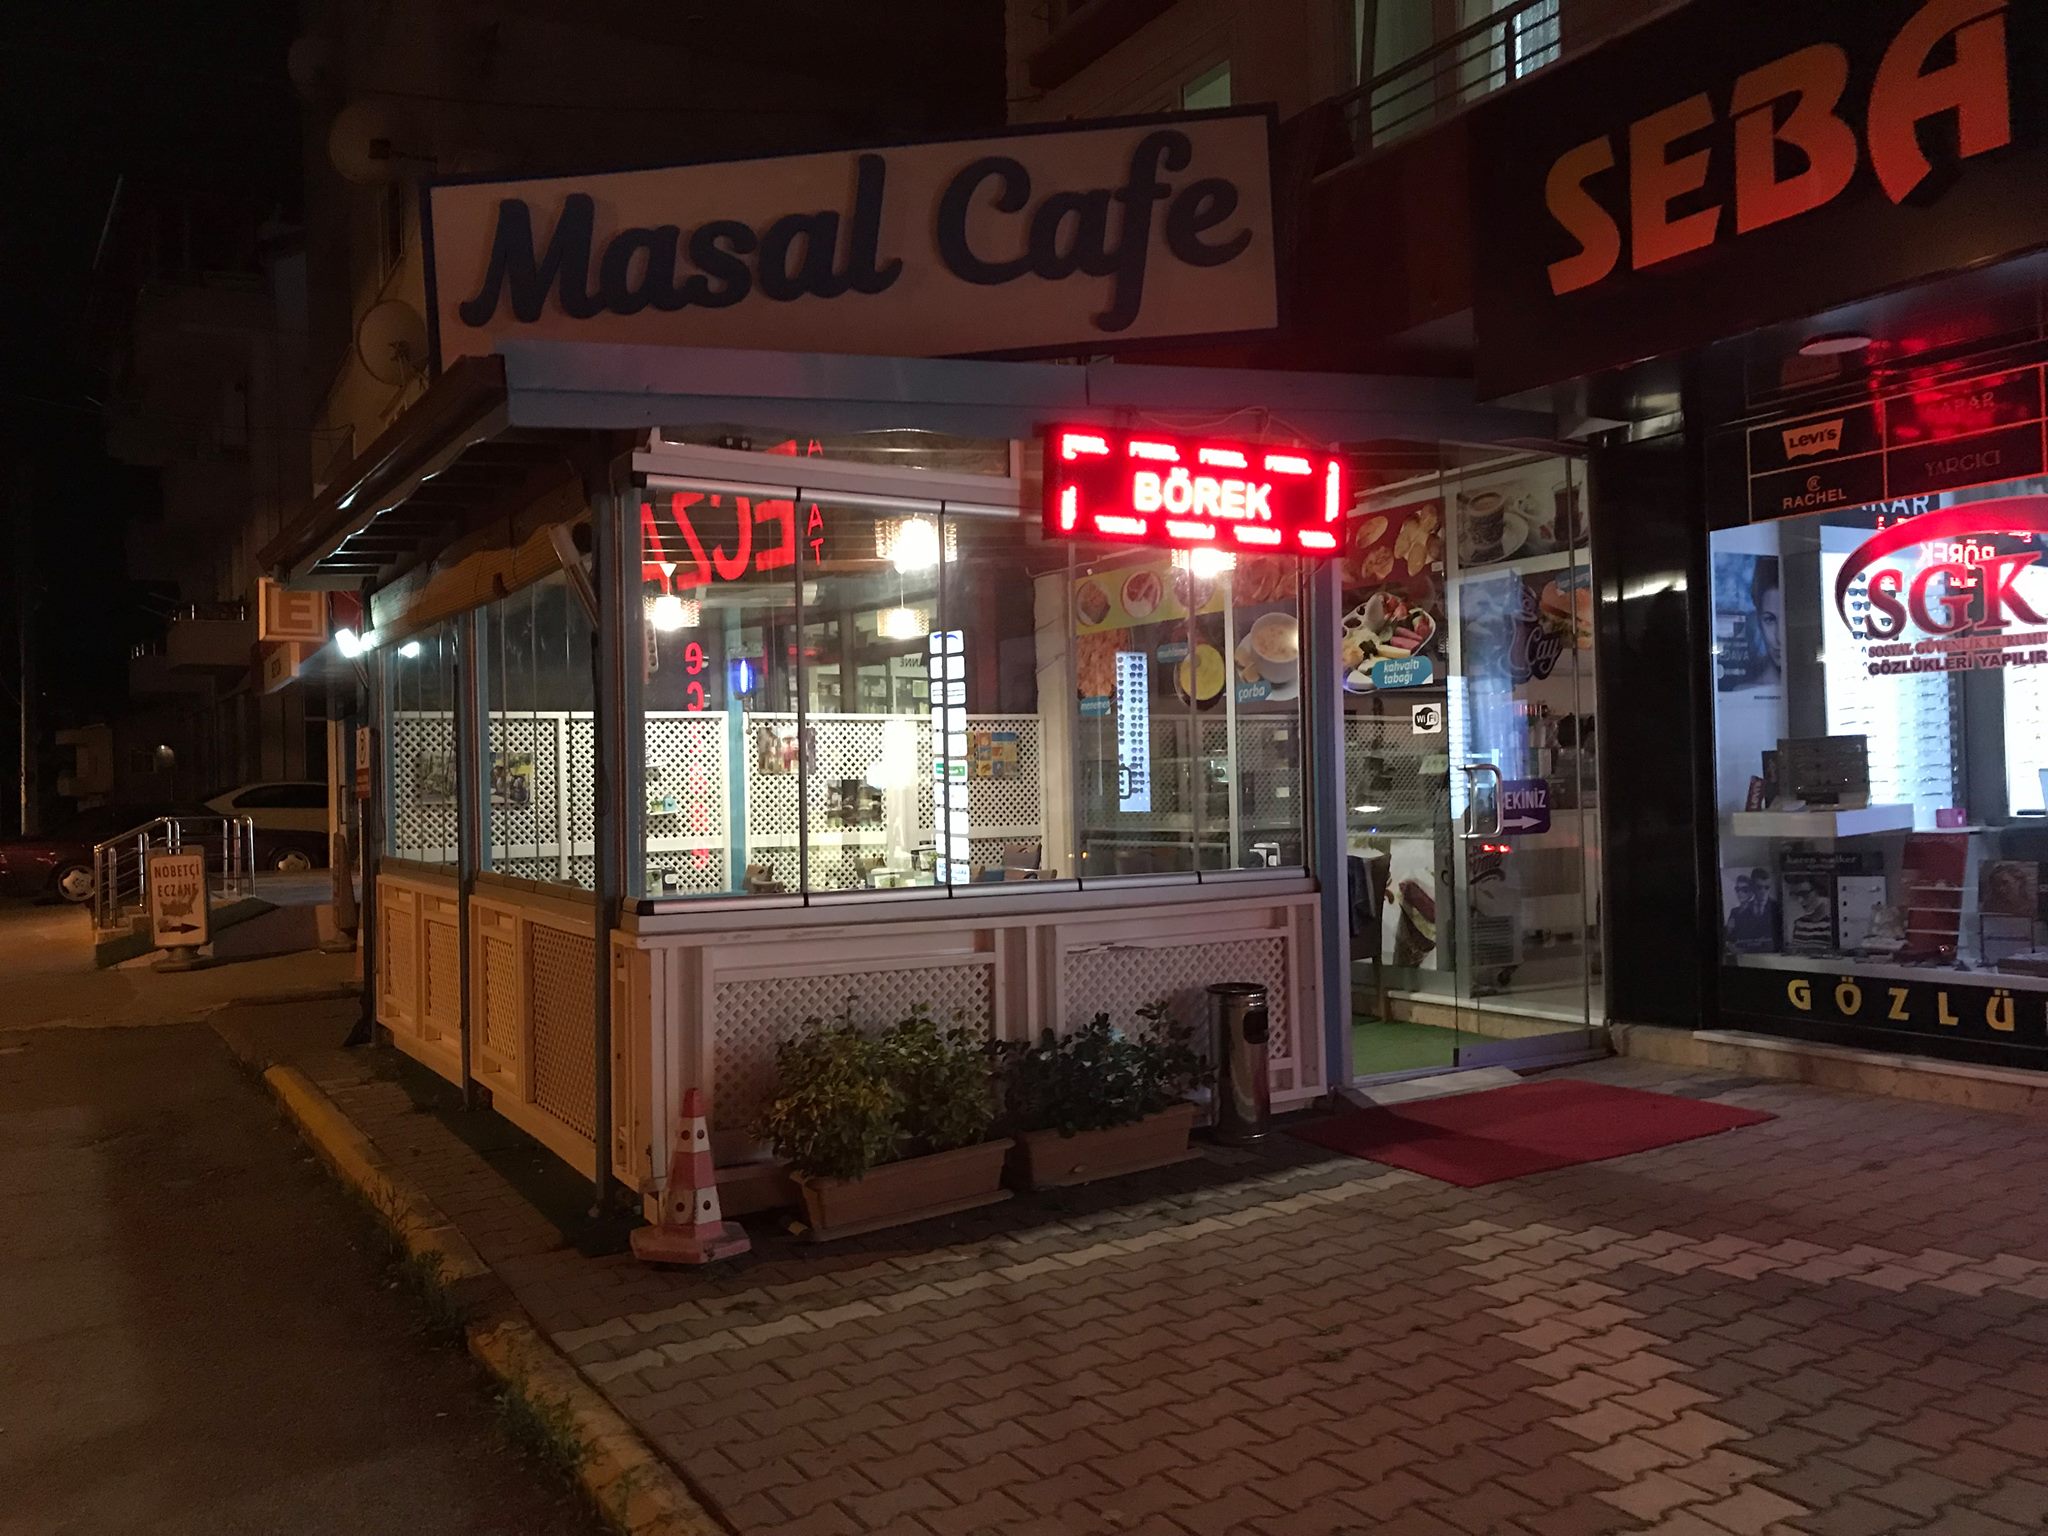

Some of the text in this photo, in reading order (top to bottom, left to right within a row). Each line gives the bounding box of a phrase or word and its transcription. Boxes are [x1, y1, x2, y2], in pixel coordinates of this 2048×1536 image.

[1545, 0, 2012, 296] SEBA
[459, 129, 1252, 332] Masal Cafe
[1133, 467, 1272, 521] BÖREK
[1782, 488, 1848, 510] RACHEL
[1865, 551, 2047, 640] SGK
[1868, 643, 1914, 658] SOSYAL
[1868, 649, 2048, 676] GÖZLÜKLERİ YAPILIR
[1238, 684, 1266, 702] çorba
[1503, 787, 1547, 810] EKİNİZ
